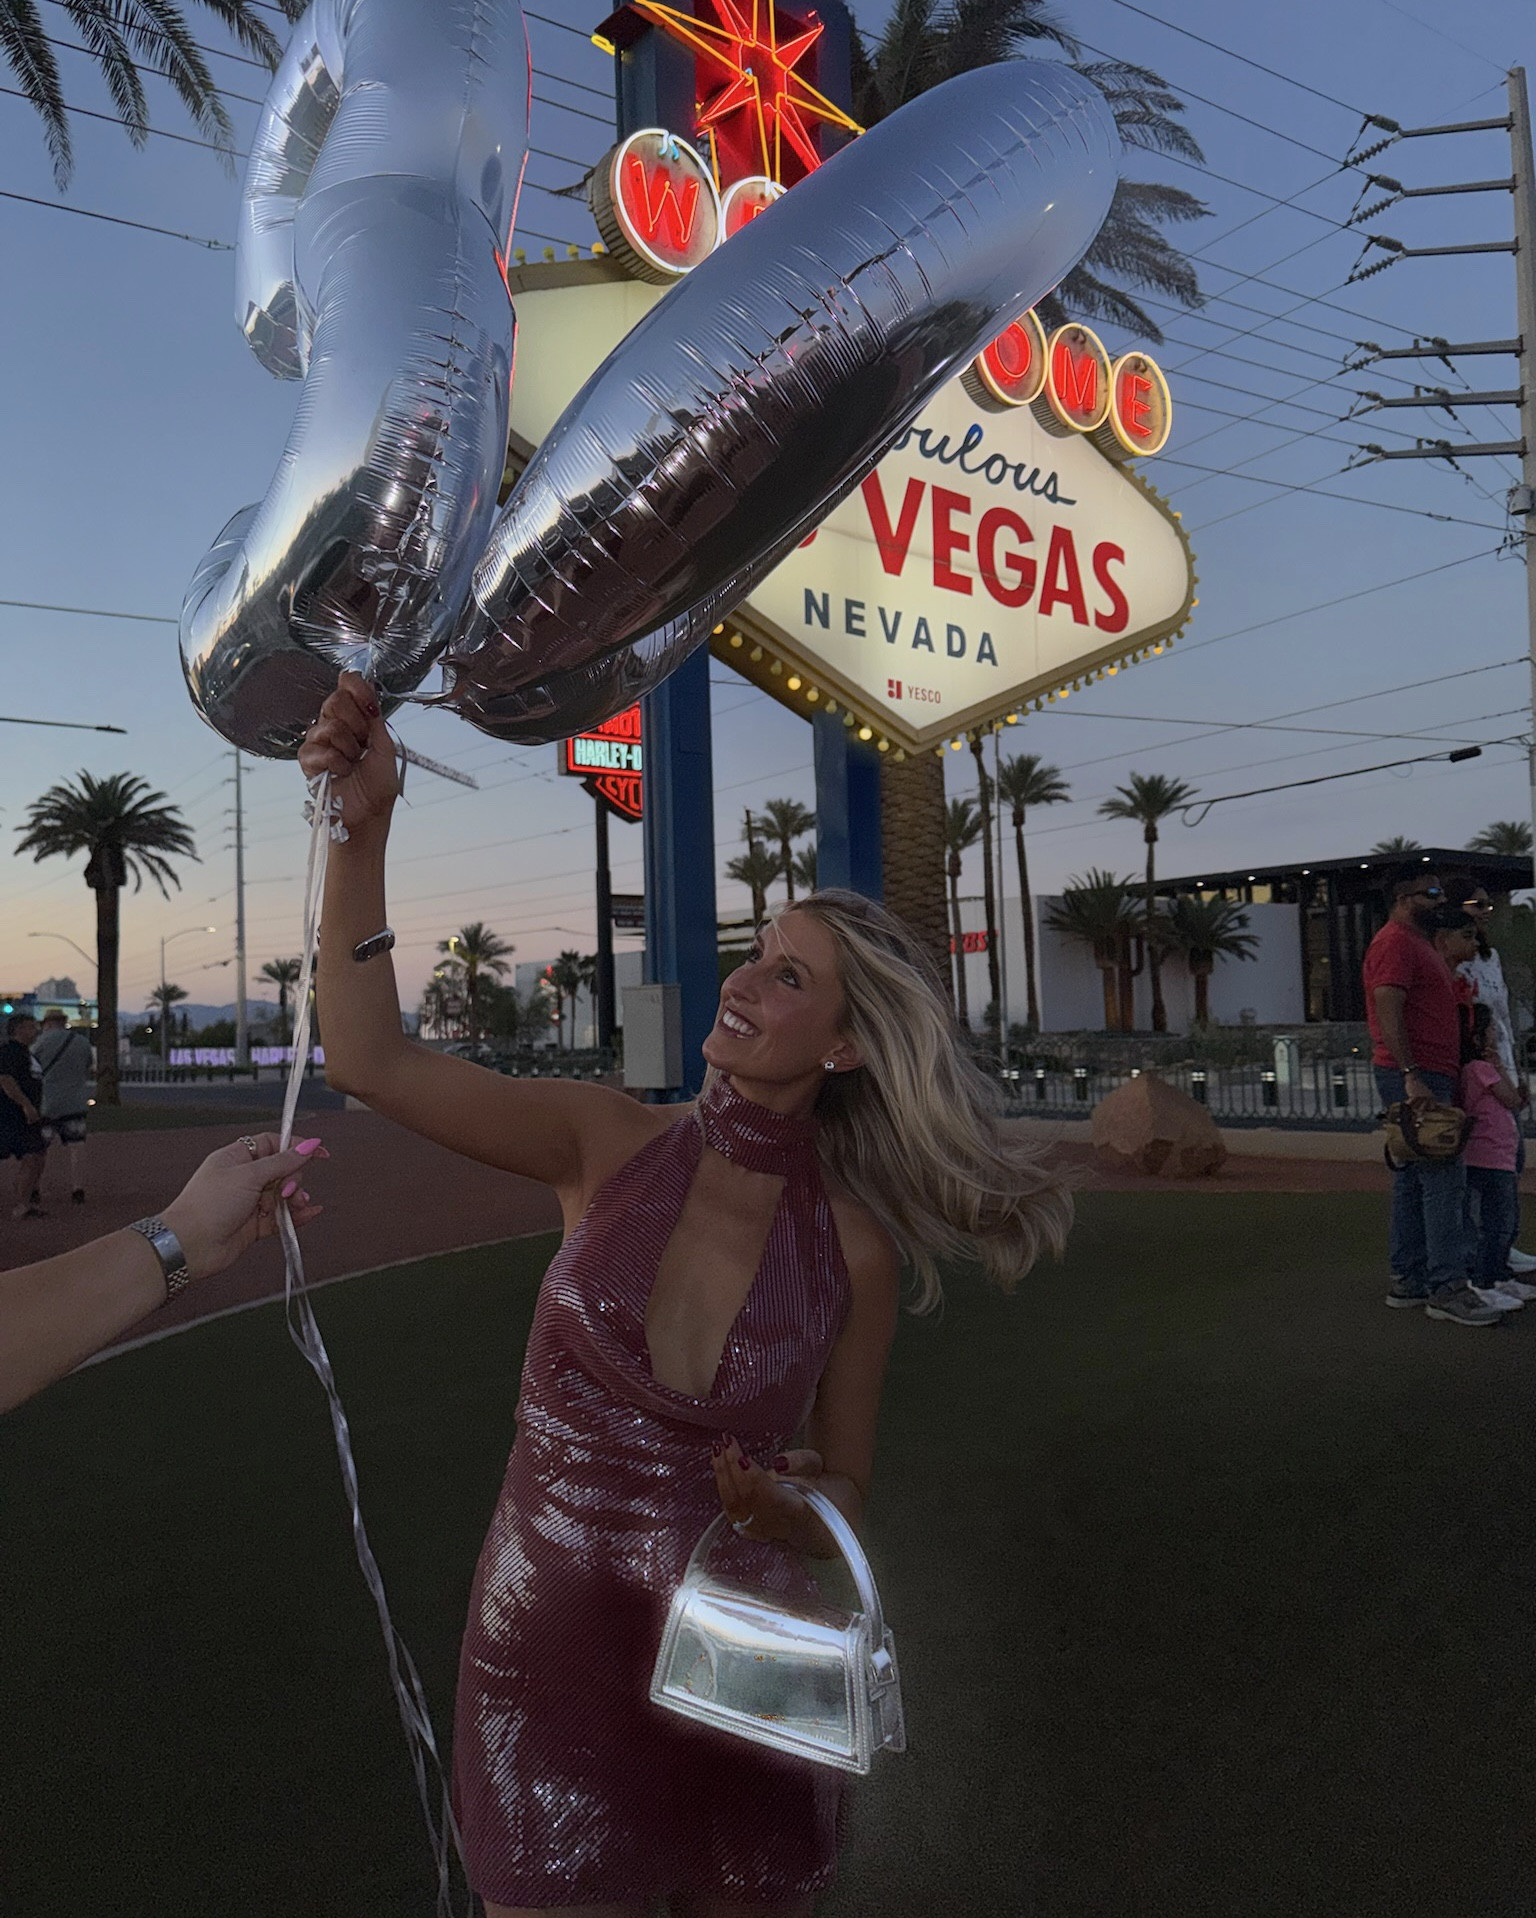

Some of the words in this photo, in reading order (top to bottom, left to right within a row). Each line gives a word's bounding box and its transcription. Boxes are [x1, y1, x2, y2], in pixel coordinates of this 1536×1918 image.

[861, 468, 1130, 634] VEGAS
[804, 588, 998, 667] NEVADA
[908, 685, 942, 704] YESCO
[574, 738, 642, 771] HARLEY-D
[605, 776, 642, 811] CYC
[194, 1047, 236, 1066] VEGAS
